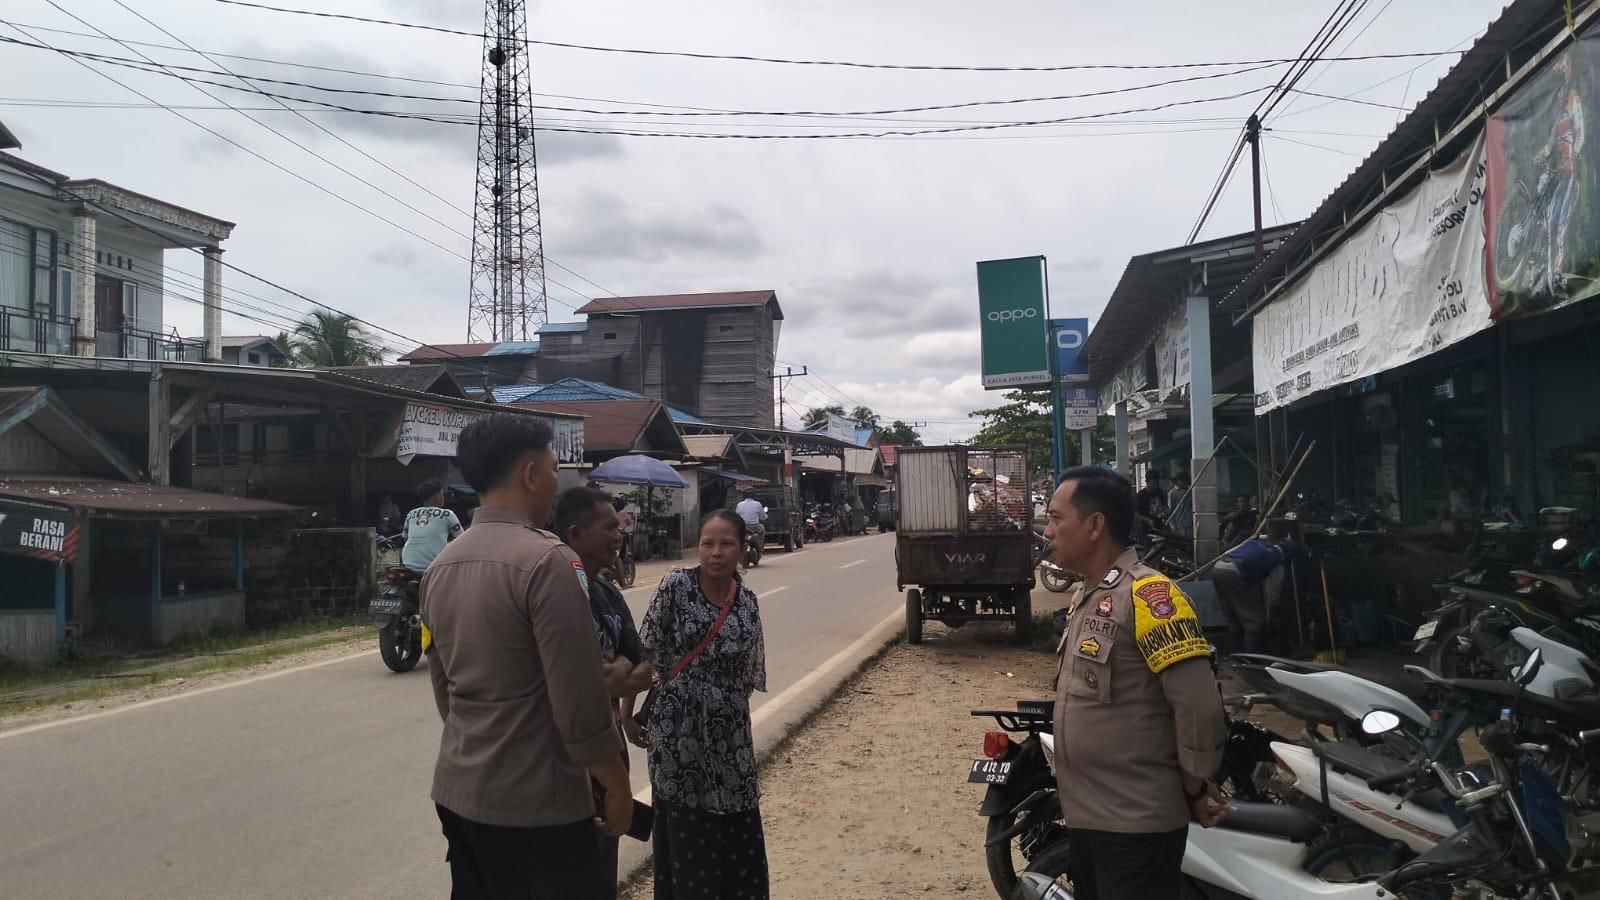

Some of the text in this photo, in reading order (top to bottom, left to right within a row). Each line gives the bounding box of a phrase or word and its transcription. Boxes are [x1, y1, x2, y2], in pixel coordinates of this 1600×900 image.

[988, 308, 1037, 323] oppo
[33, 518, 65, 537] RASA
[20, 531, 64, 552] BERANI
[944, 552, 986, 564] VIAR
[1084, 618, 1116, 635] POLRI
[973, 760, 981, 772] K
